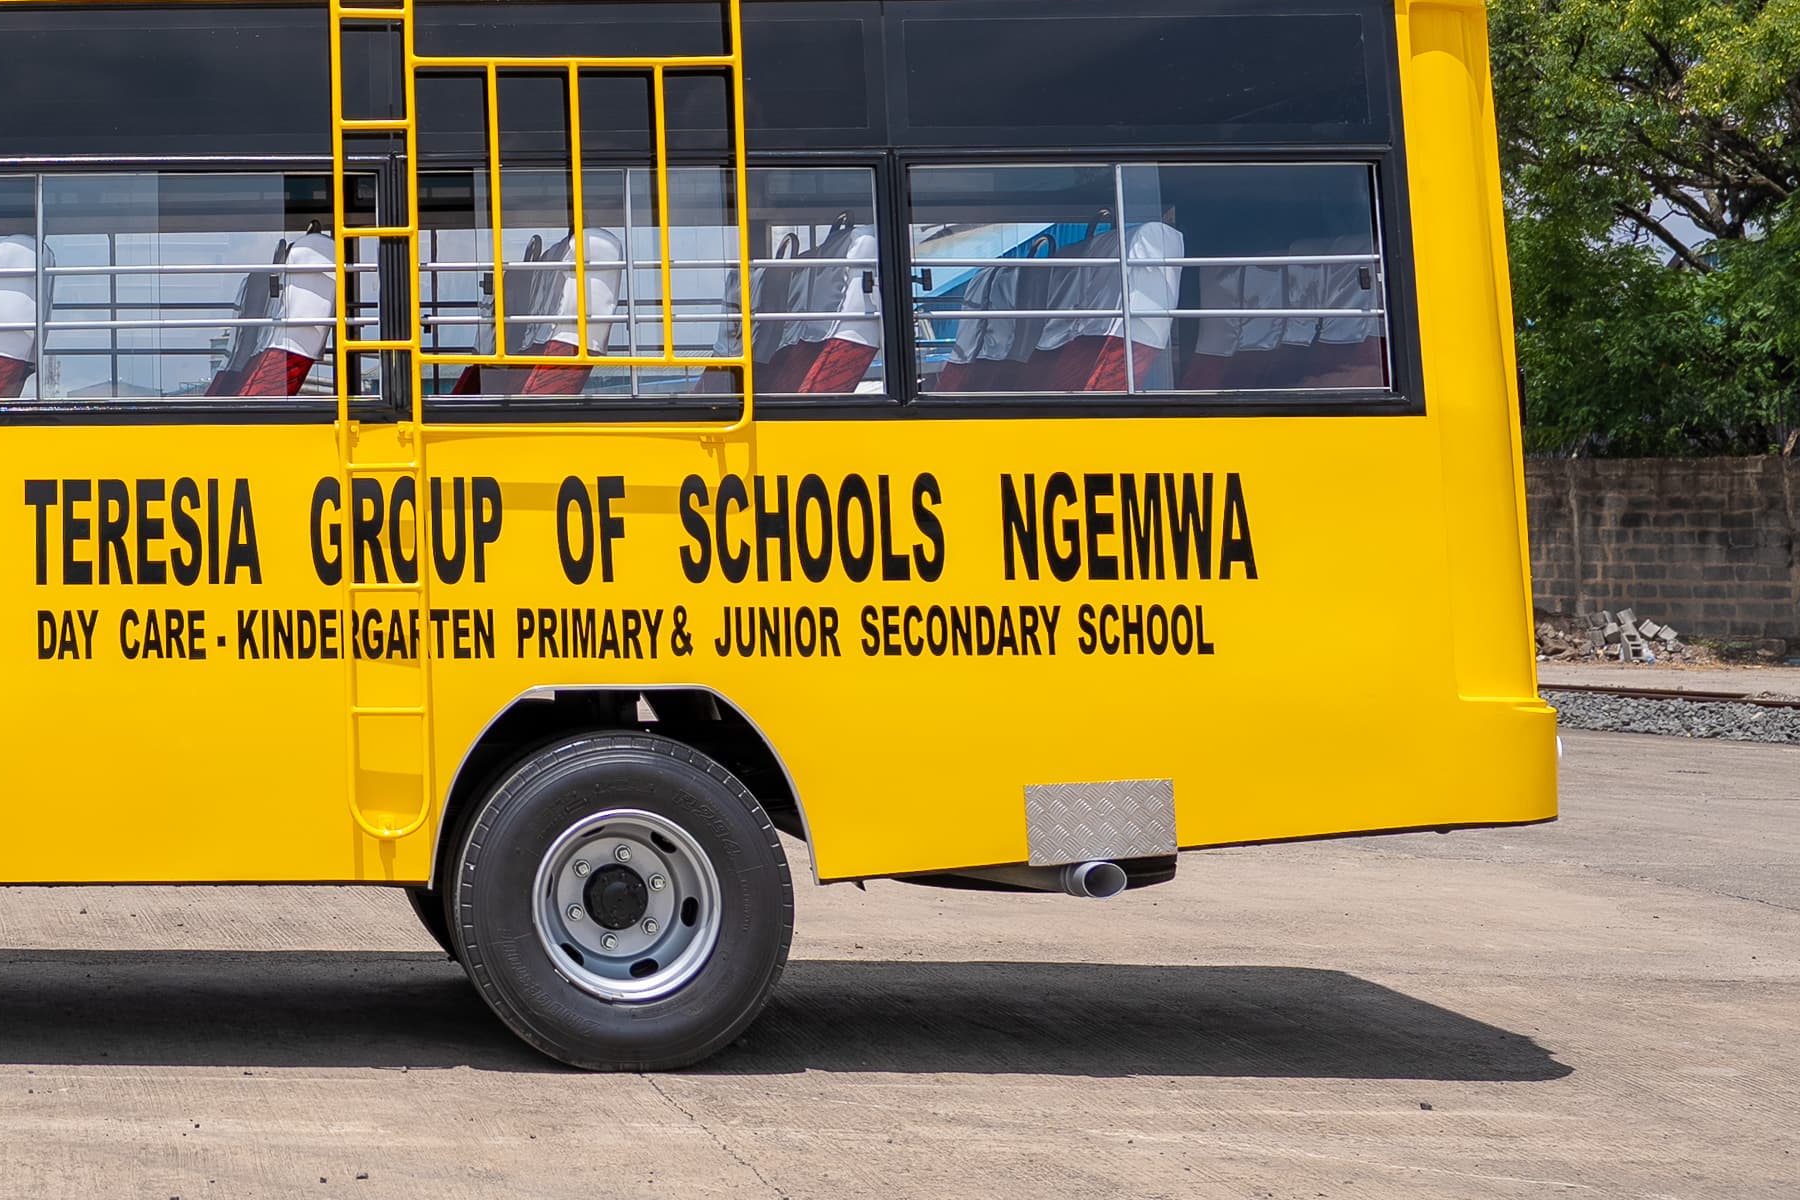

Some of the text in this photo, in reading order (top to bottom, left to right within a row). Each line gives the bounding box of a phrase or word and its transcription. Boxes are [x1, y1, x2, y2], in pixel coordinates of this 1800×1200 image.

[24, 477, 263, 586] TERESIA
[311, 476, 503, 586] GROUP
[556, 475, 626, 585] OF
[679, 473, 945, 584] SCHOOLS
[1000, 471, 1258, 582] NGEMWA
[37, 609, 99, 660] DAY
[119, 608, 207, 660] CARE
[714, 606, 842, 658] JUNIOR
[860, 604, 1061, 657] SECONDARY
[1078, 603, 1215, 656] SCHOOL
